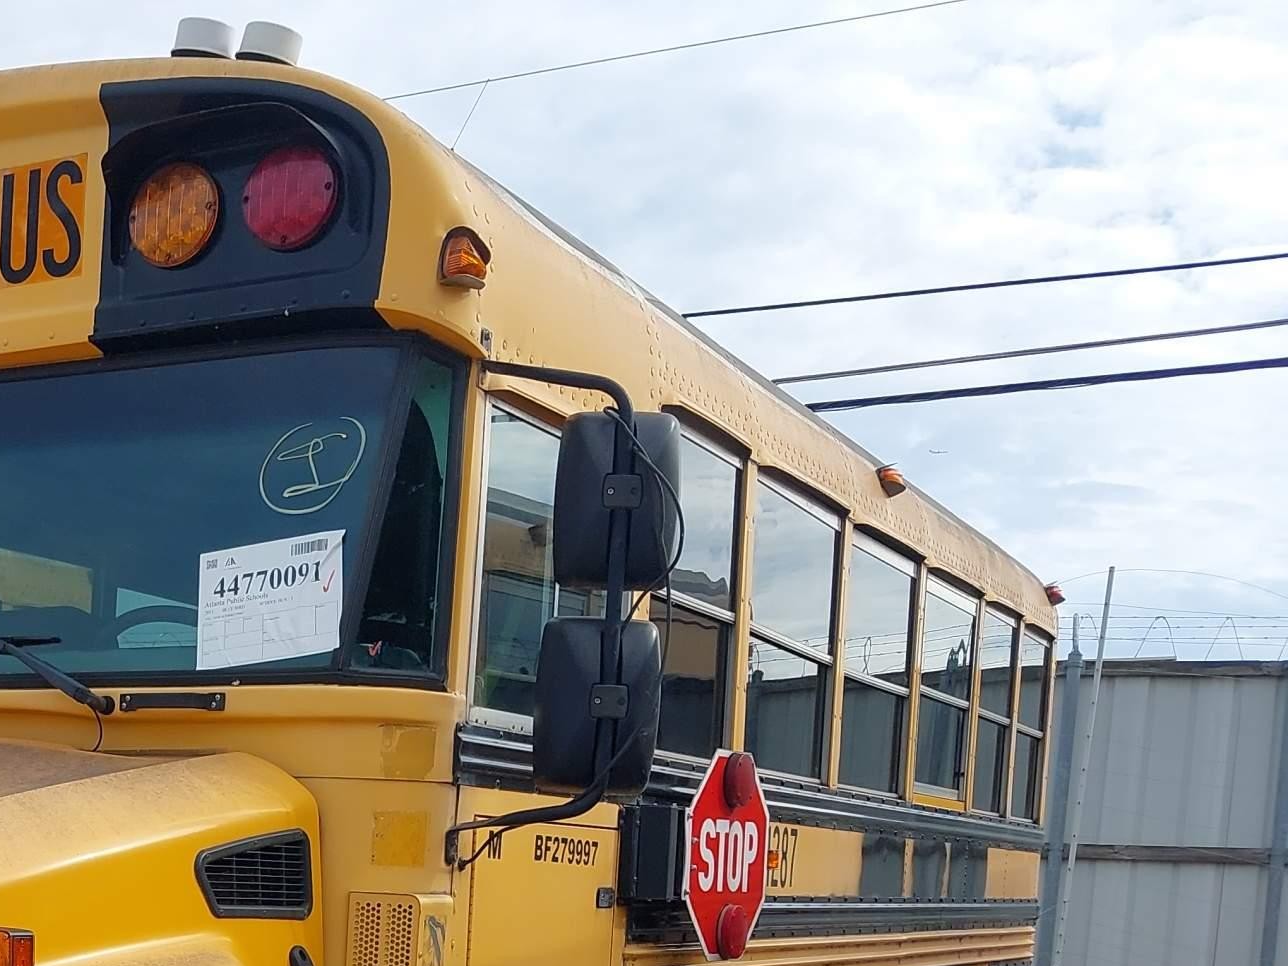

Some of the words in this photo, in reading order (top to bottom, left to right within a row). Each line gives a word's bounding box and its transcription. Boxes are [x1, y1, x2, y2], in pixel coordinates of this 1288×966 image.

[213, 560, 321, 598] 44770091
[488, 830, 503, 859] M
[534, 834, 599, 867] BF279997
[697, 819, 757, 893] STOP
[766, 825, 798, 889] 1287
